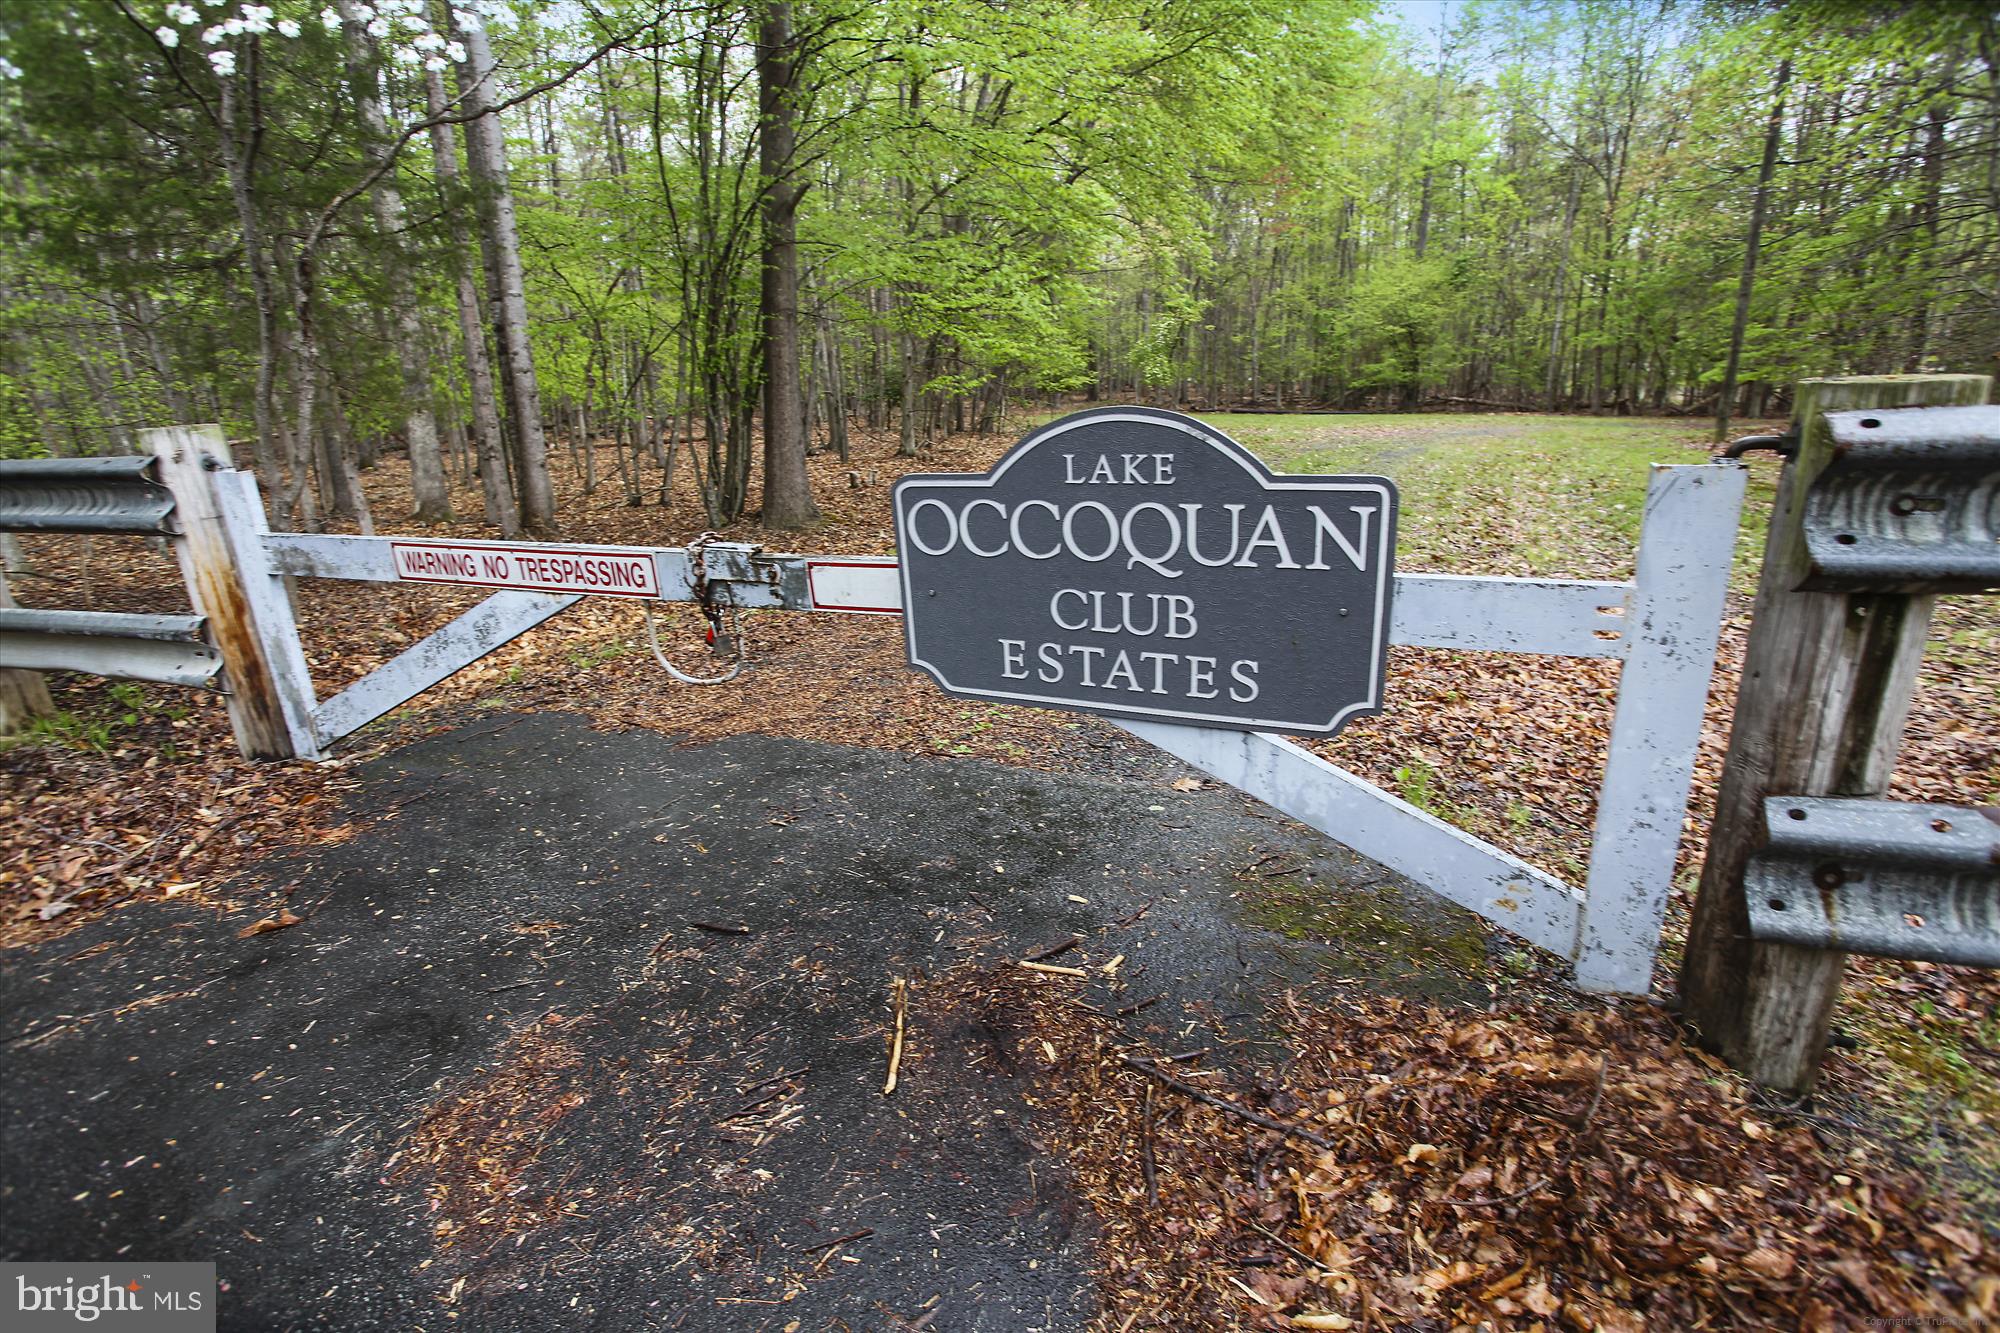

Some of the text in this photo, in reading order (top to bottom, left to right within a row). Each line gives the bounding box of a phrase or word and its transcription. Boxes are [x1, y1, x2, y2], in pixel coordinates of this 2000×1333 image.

[1062, 453, 1177, 485] LAKE
[907, 498, 1378, 579] OCCOQUAN
[401, 551, 646, 588] WARNING NO TRESPASSING
[1050, 588, 1198, 640] CLUB
[999, 638, 1260, 704] ESTATES
